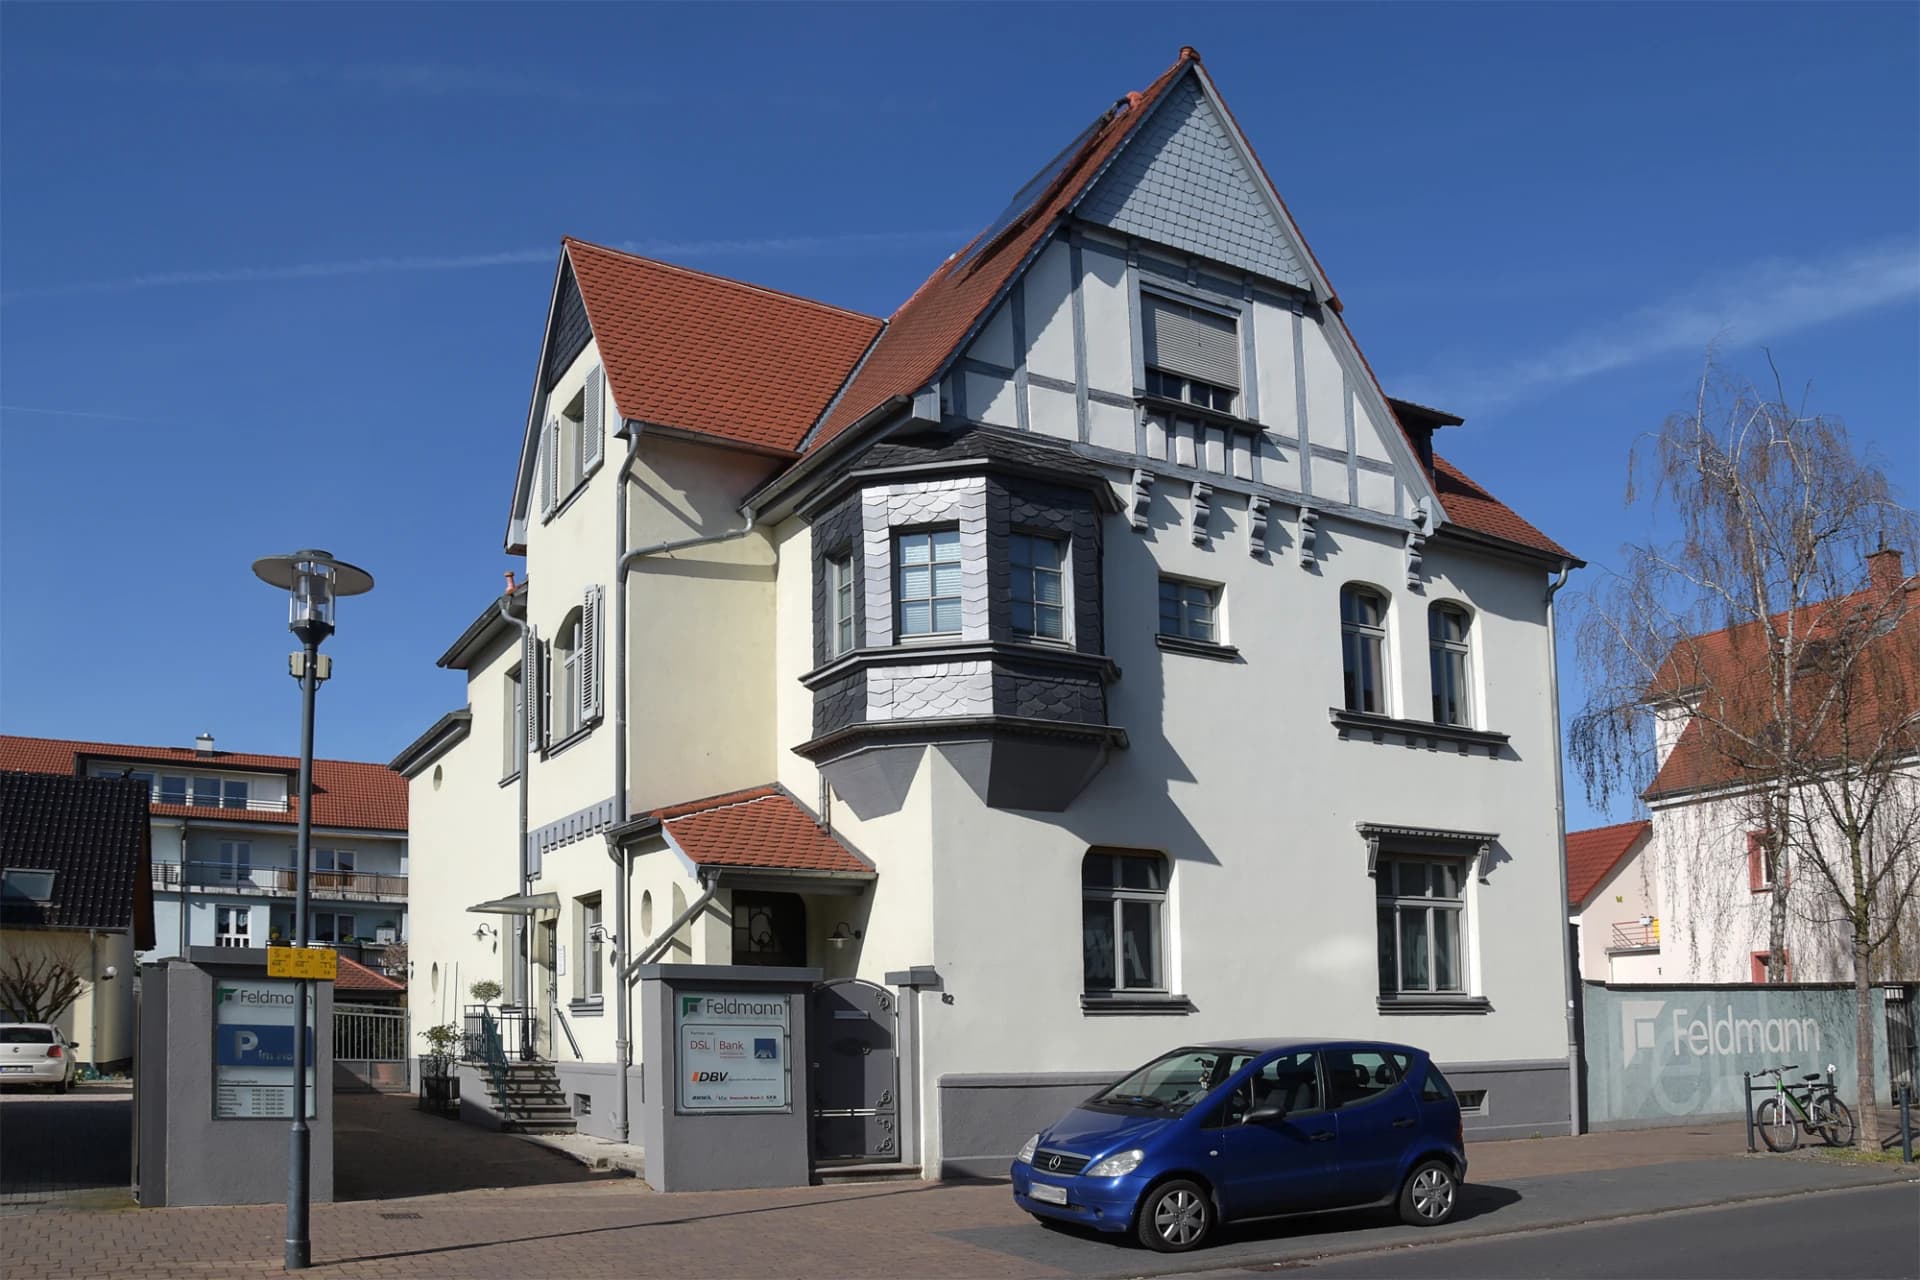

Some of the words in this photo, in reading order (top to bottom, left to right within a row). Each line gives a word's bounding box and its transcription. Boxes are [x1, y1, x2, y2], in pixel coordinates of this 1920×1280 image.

[240, 989, 313, 1005] Feldman
[706, 998, 783, 1016] Feldmann
[1672, 1004, 1821, 1057] Feldmann
[235, 1030, 259, 1060] P
[690, 1040, 711, 1050] DSL
[720, 1040, 744, 1050] Bank
[698, 1072, 729, 1082] DBV
